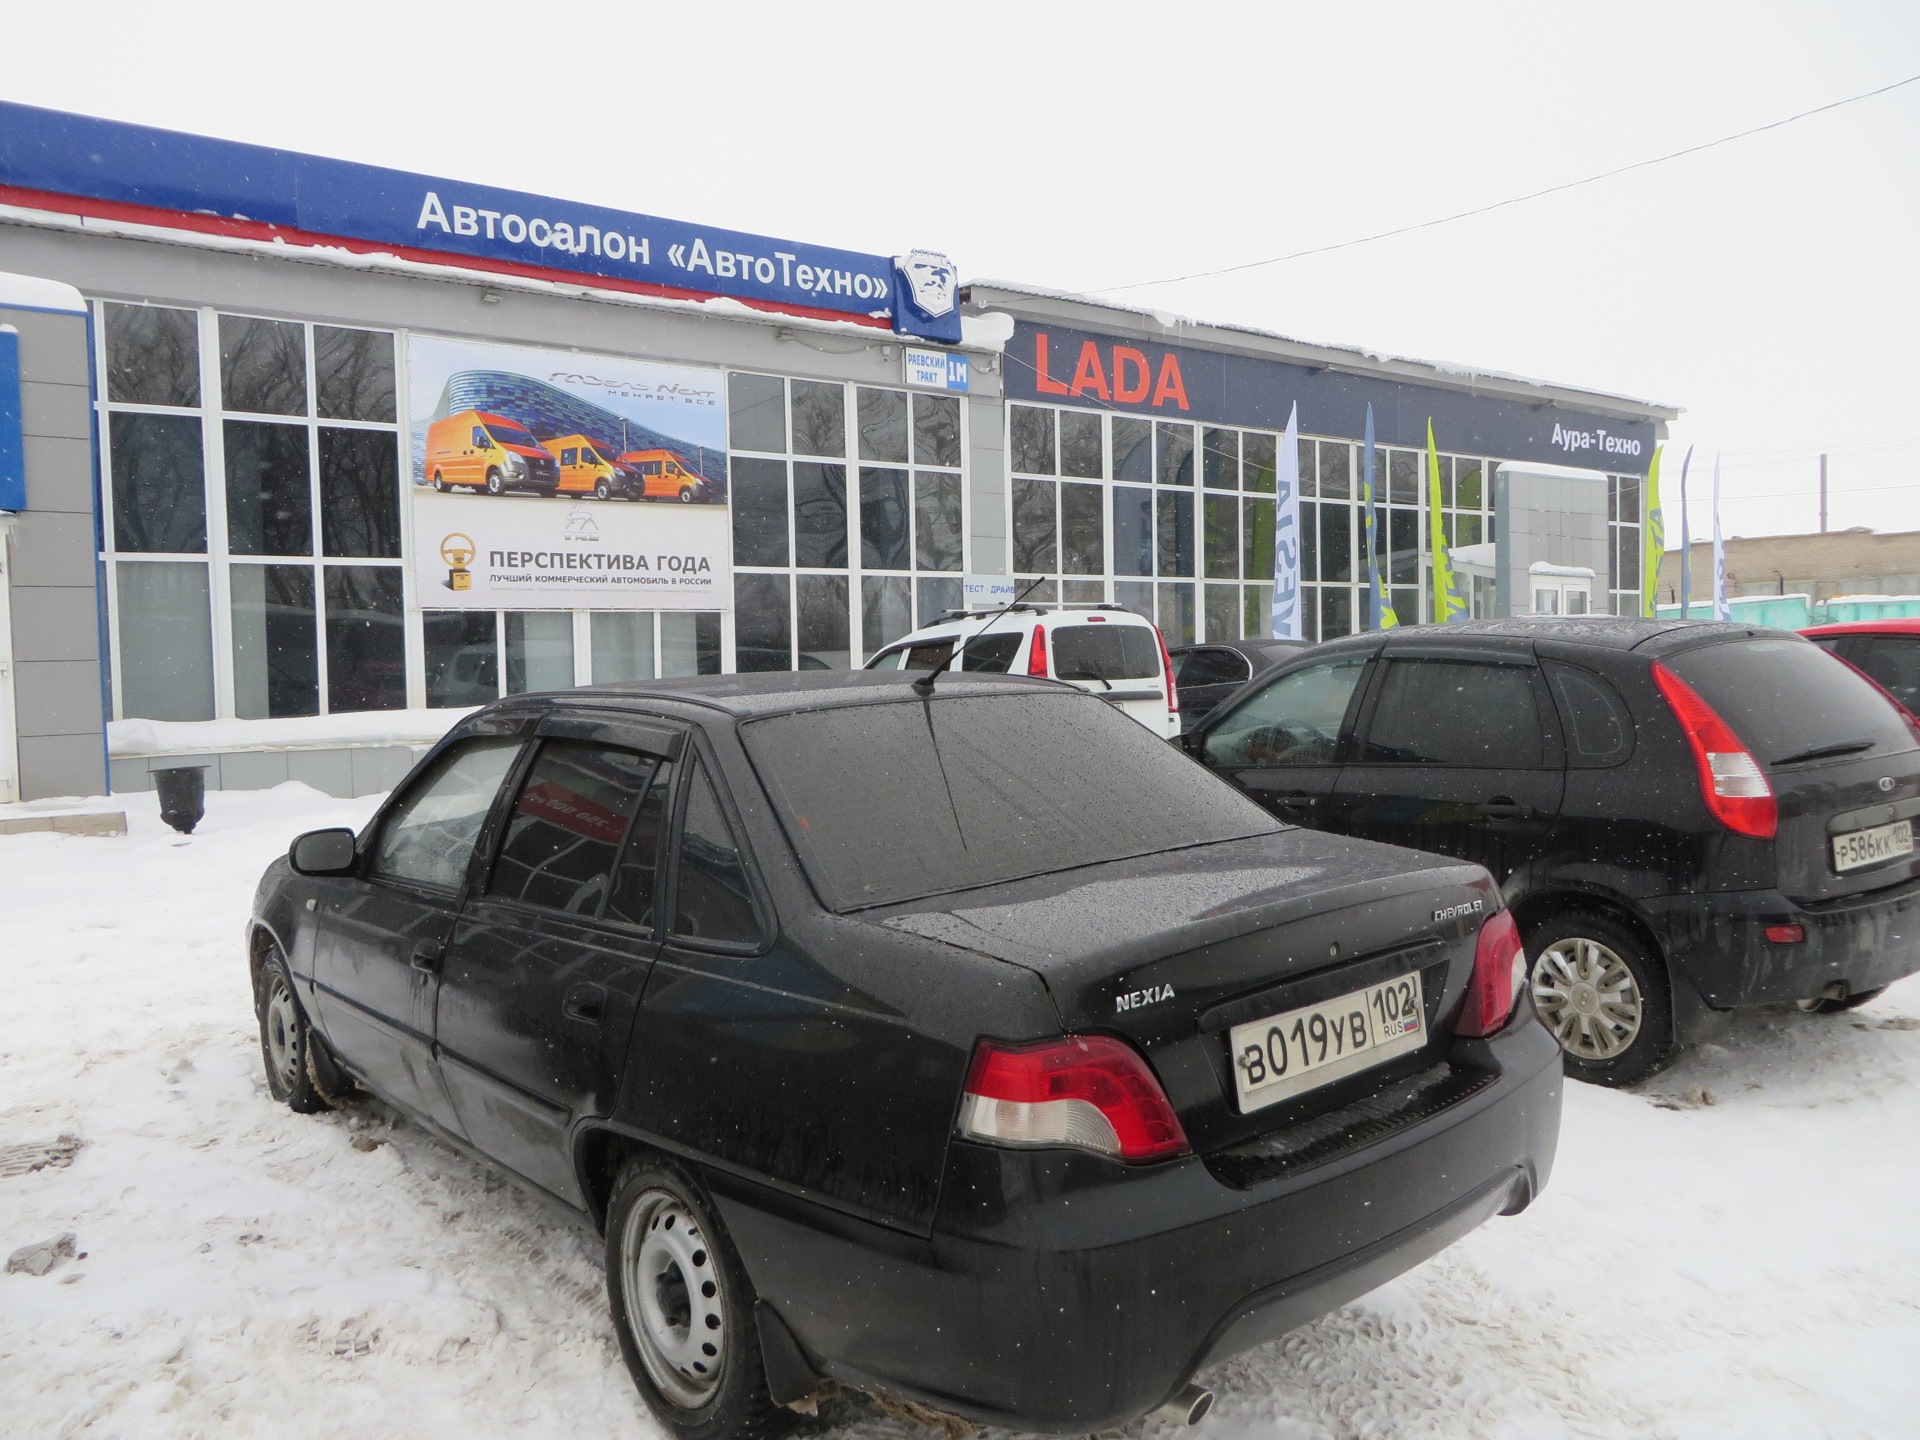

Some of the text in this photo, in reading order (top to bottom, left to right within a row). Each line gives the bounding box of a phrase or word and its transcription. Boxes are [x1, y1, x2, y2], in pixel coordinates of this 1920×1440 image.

[417, 191, 888, 299] Автосалон «АвтоТехно»
[908, 354, 945, 369] РАЕВСКИЙ
[1036, 333, 1190, 410] LADA
[916, 370, 938, 384] ТРАКТ
[608, 390, 716, 406] МЕНЯЕТ ВСЕ
[1551, 422, 1641, 456] Аура-Техно
[489, 550, 650, 571] ПЕРСПЕКТИВА
[489, 573, 712, 586] ЛУЧШИЙ КОММЕРЧЕСКИЙ АВТОМОБИЛЬ В РОССИИ
[964, 584, 984, 593] ТЕСТ
[990, 584, 1016, 594] ДРАЙВ
[1433, 899, 1483, 922] CHEVROLET
[1115, 983, 1175, 1013] NEXIA
[1372, 981, 1413, 1025] 102
[1383, 1021, 1404, 1039] RUS
